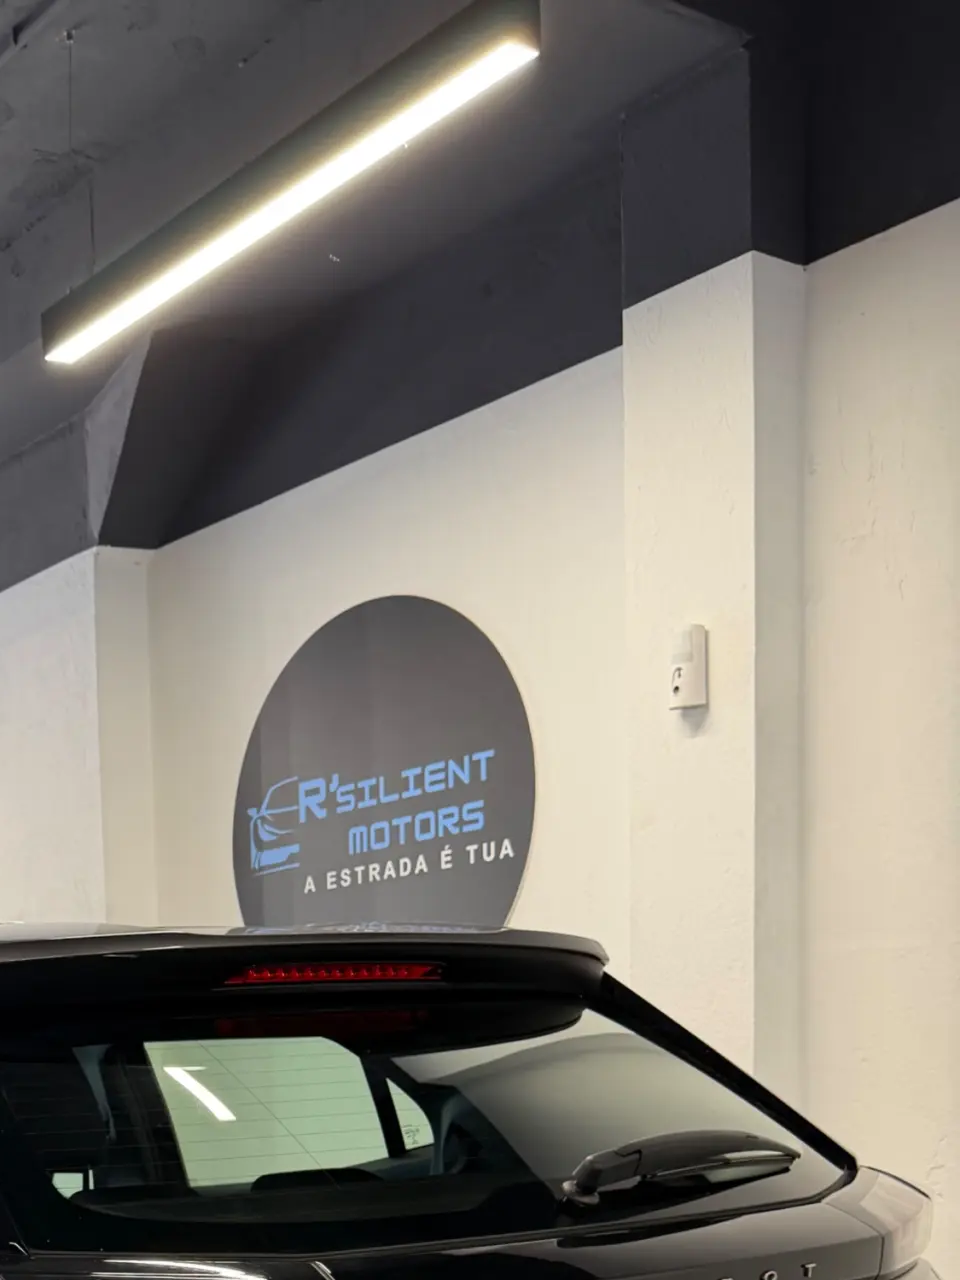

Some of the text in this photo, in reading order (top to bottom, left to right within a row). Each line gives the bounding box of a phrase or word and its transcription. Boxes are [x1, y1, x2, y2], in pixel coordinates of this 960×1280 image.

[348, 800, 485, 856] MOTORS
[303, 839, 515, 893] A ESTRADA É TUA
